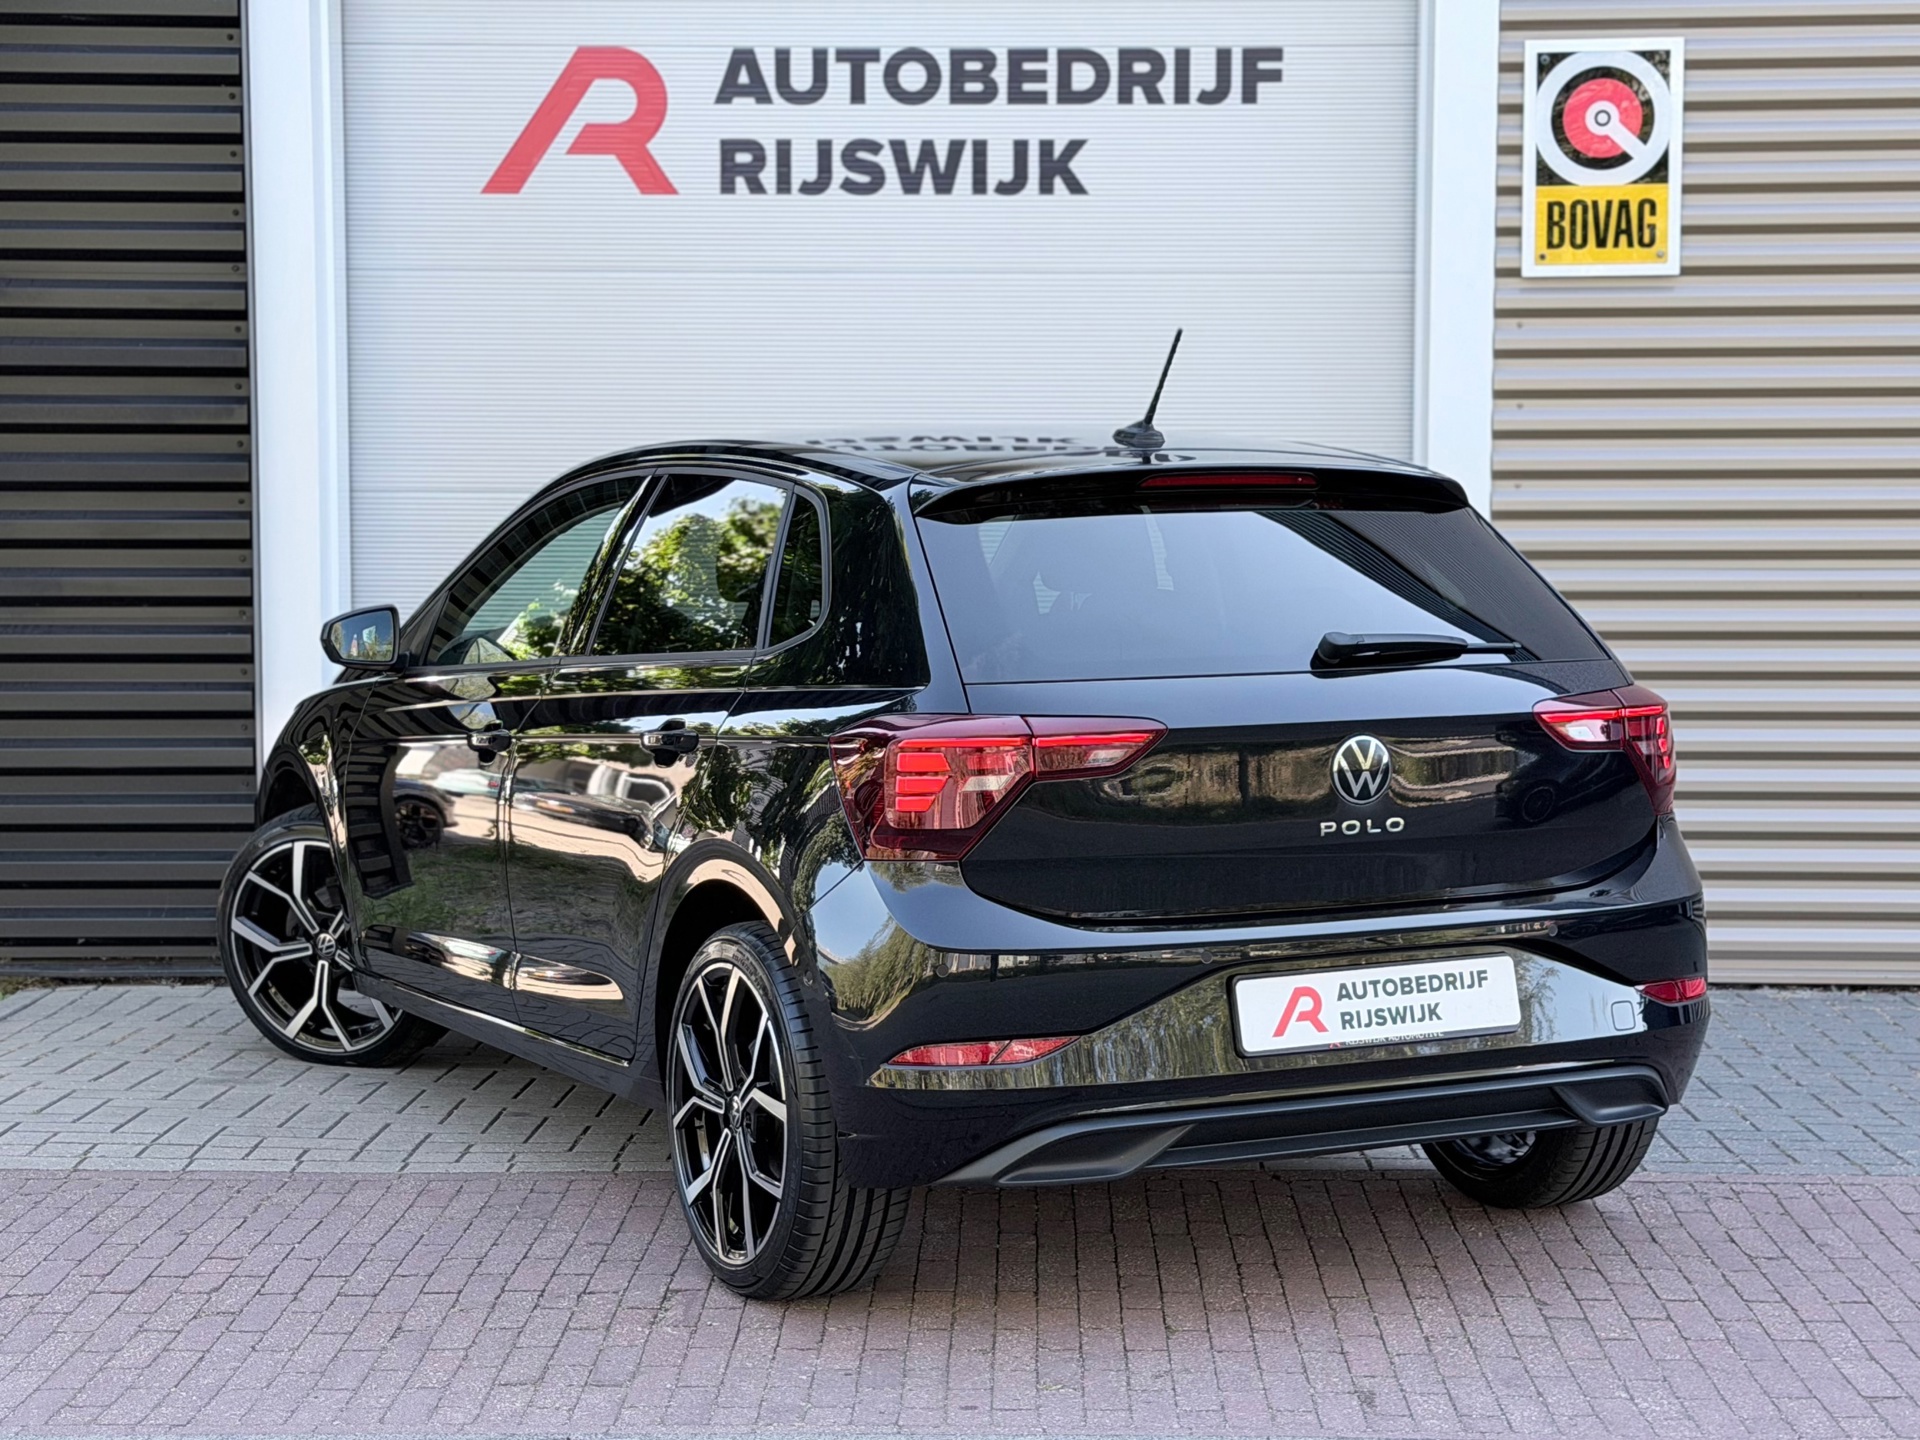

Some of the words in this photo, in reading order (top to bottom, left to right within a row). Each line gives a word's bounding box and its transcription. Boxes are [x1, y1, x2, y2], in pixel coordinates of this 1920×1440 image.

[714, 46, 1284, 105] AUTOBEDRIJF
[720, 138, 1089, 195] RIJSWIJK
[1546, 198, 1657, 250] BOVAG
[1320, 817, 1405, 837] POLO
[1336, 969, 1489, 1001] AUTOBEDRIJF
[1339, 1002, 1442, 1030] RIJSWIJK
